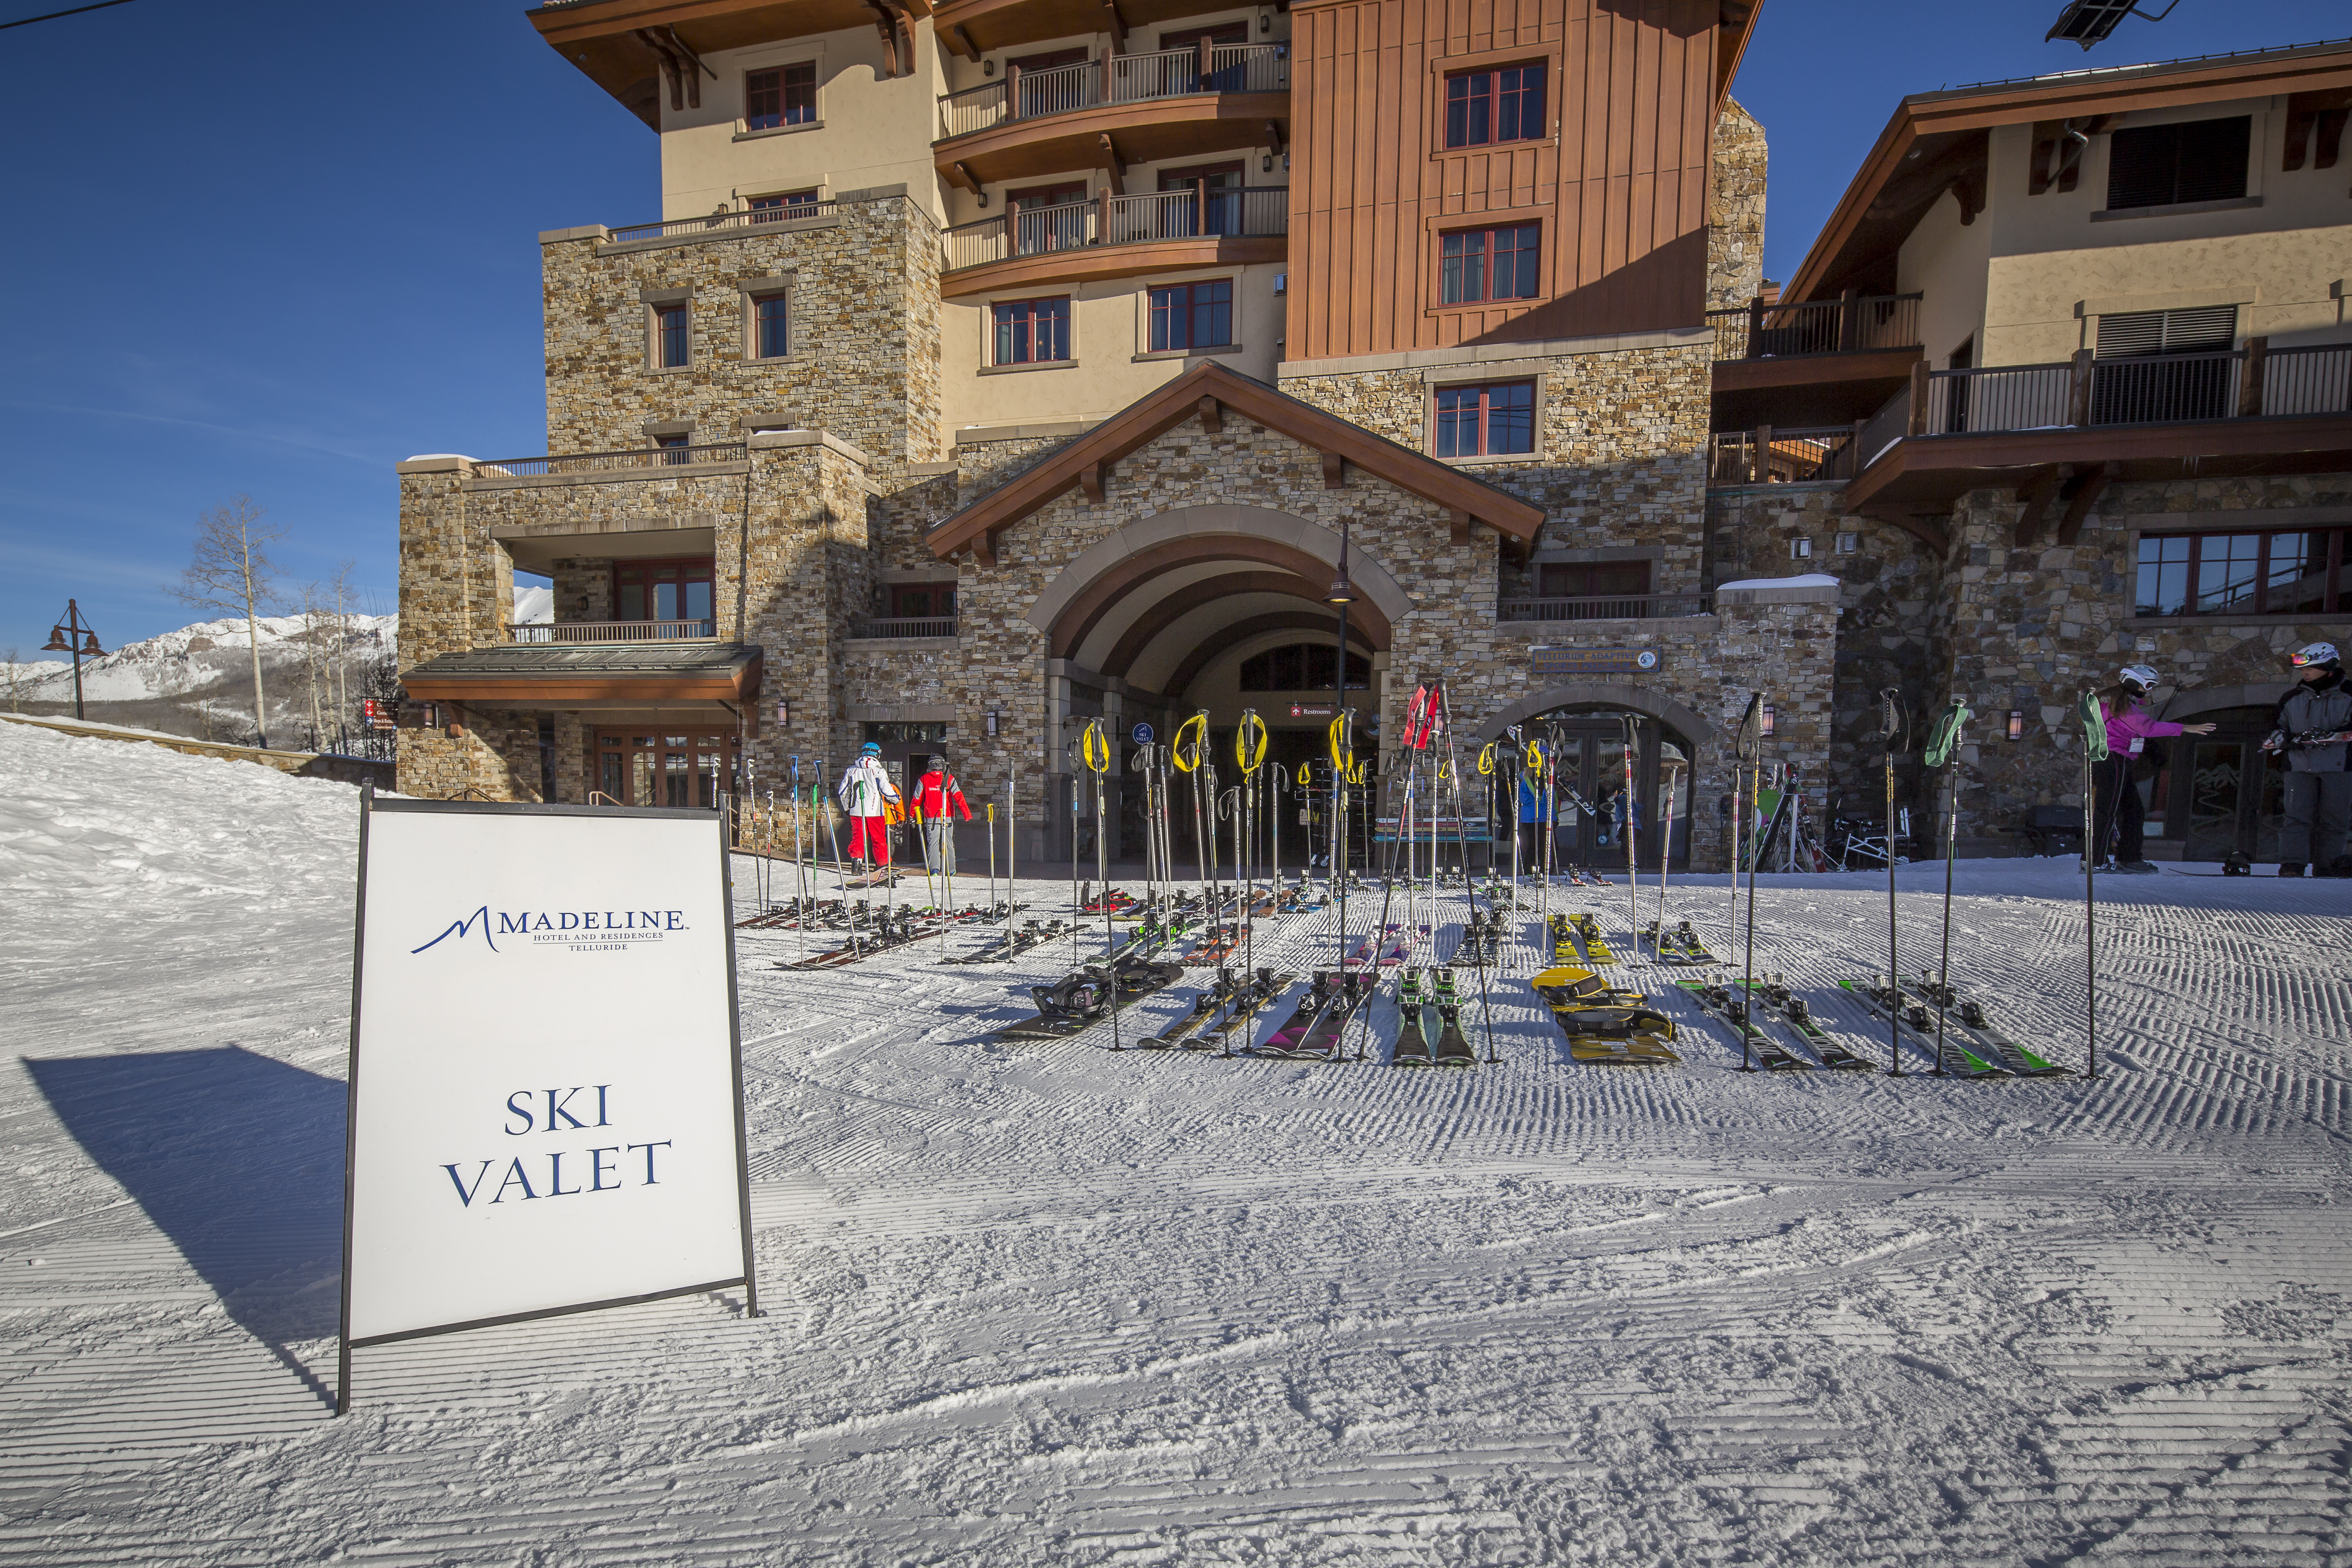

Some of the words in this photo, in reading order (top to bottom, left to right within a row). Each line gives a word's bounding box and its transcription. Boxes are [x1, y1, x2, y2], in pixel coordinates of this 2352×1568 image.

[497, 910, 685, 933] MADELINE
[505, 1084, 612, 1136] SKI
[439, 1139, 672, 1208] VALET
